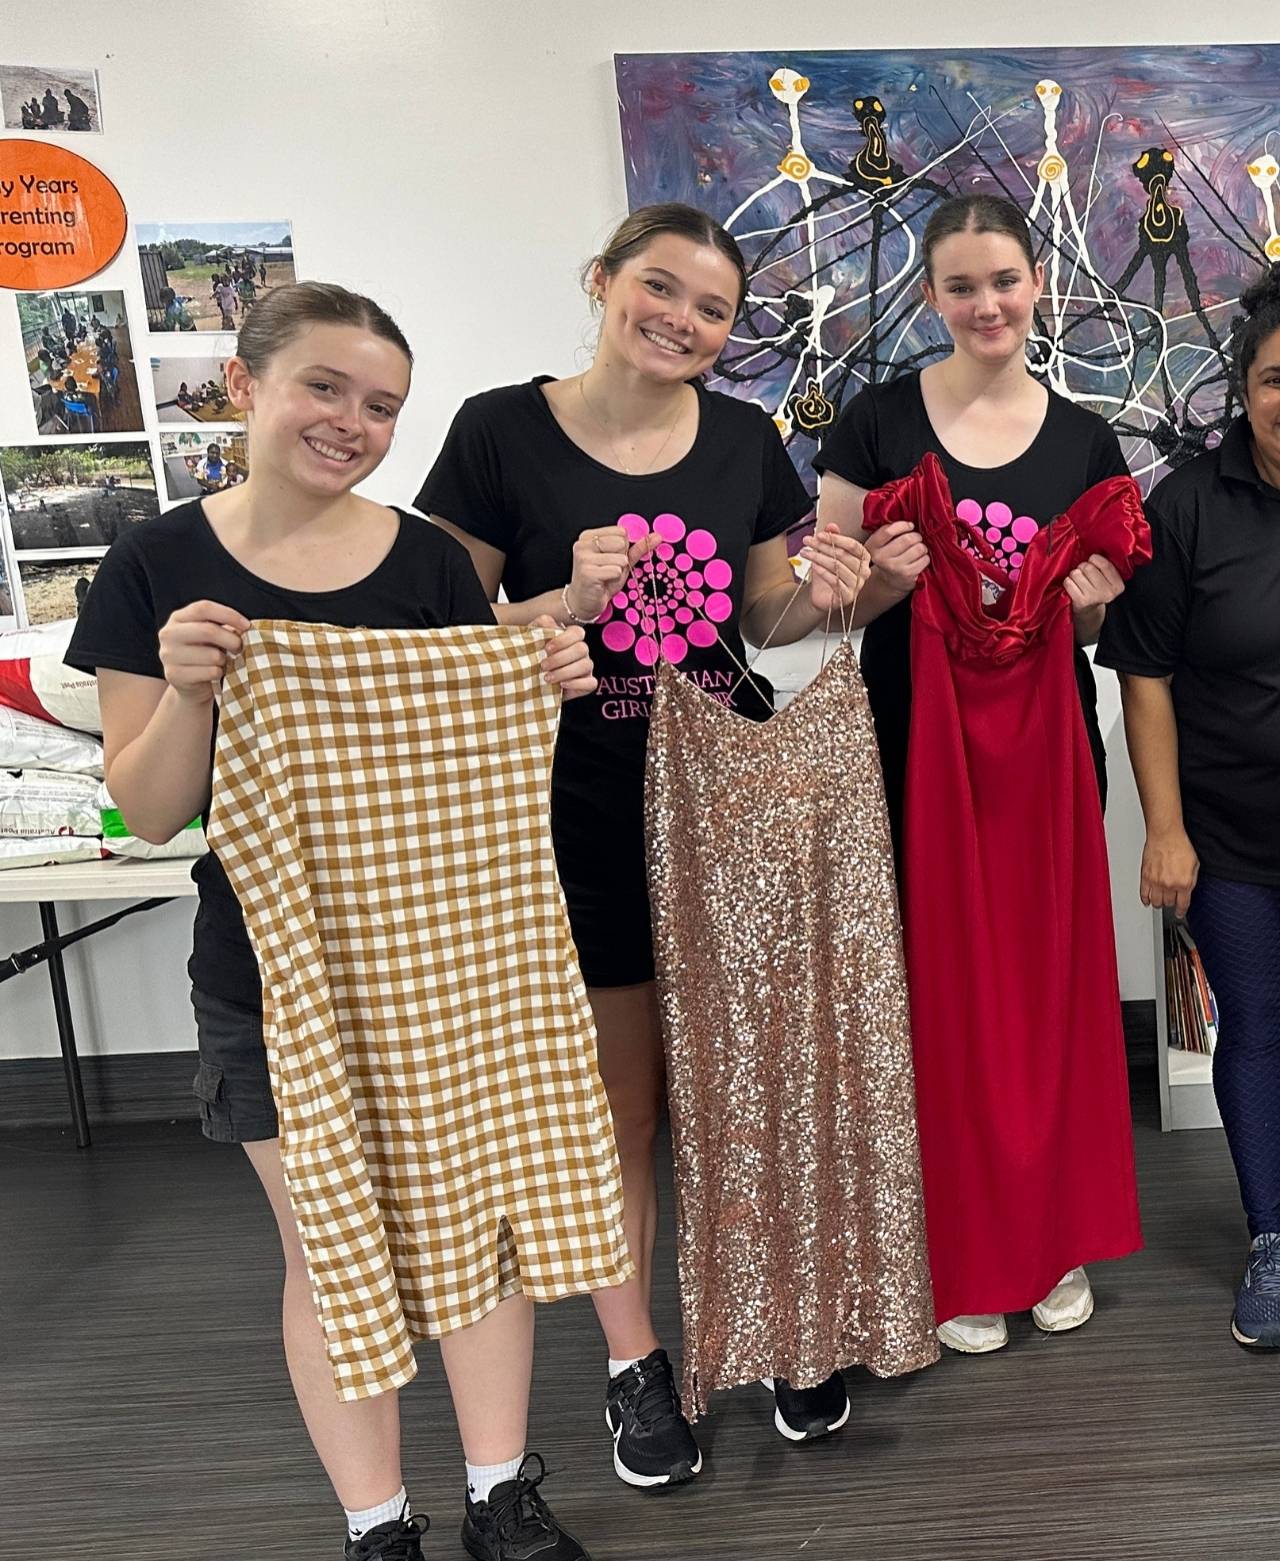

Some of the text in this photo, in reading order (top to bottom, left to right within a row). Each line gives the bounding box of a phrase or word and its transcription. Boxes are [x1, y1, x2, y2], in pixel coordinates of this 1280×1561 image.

[0, 174, 78, 198] y Years
[0, 206, 76, 227] renting
[0, 240, 75, 258] rogram
[596, 669, 734, 696] AUSTIAN
